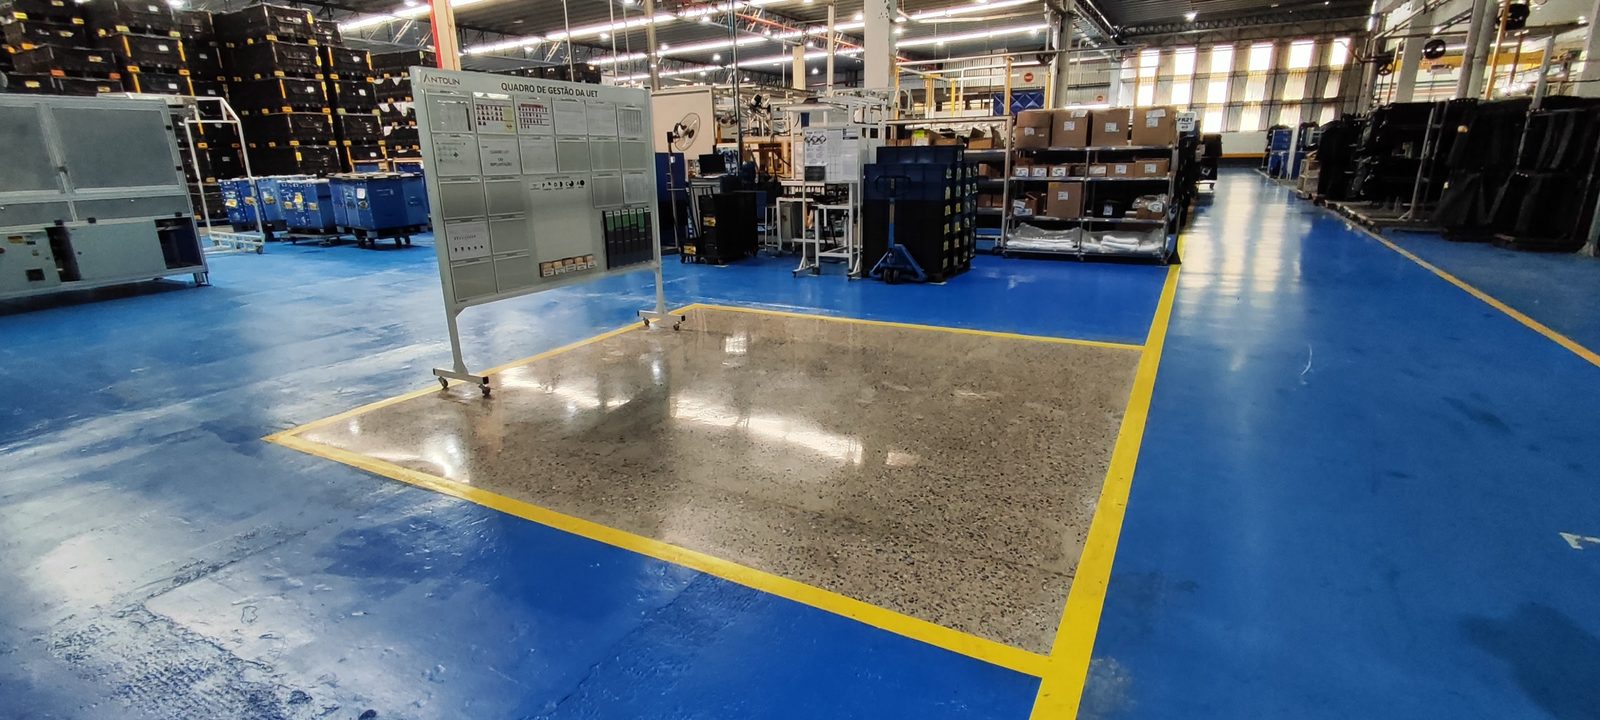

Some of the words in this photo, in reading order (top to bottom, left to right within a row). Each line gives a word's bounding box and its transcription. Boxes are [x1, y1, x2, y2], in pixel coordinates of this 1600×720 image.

[423, 73, 461, 85] ANTOLIN
[501, 82, 535, 93] QUADRO
[536, 85, 546, 94] DE
[547, 86, 574, 96] GESTÃO
[575, 88, 585, 97] DA
[586, 90, 598, 98] UET
